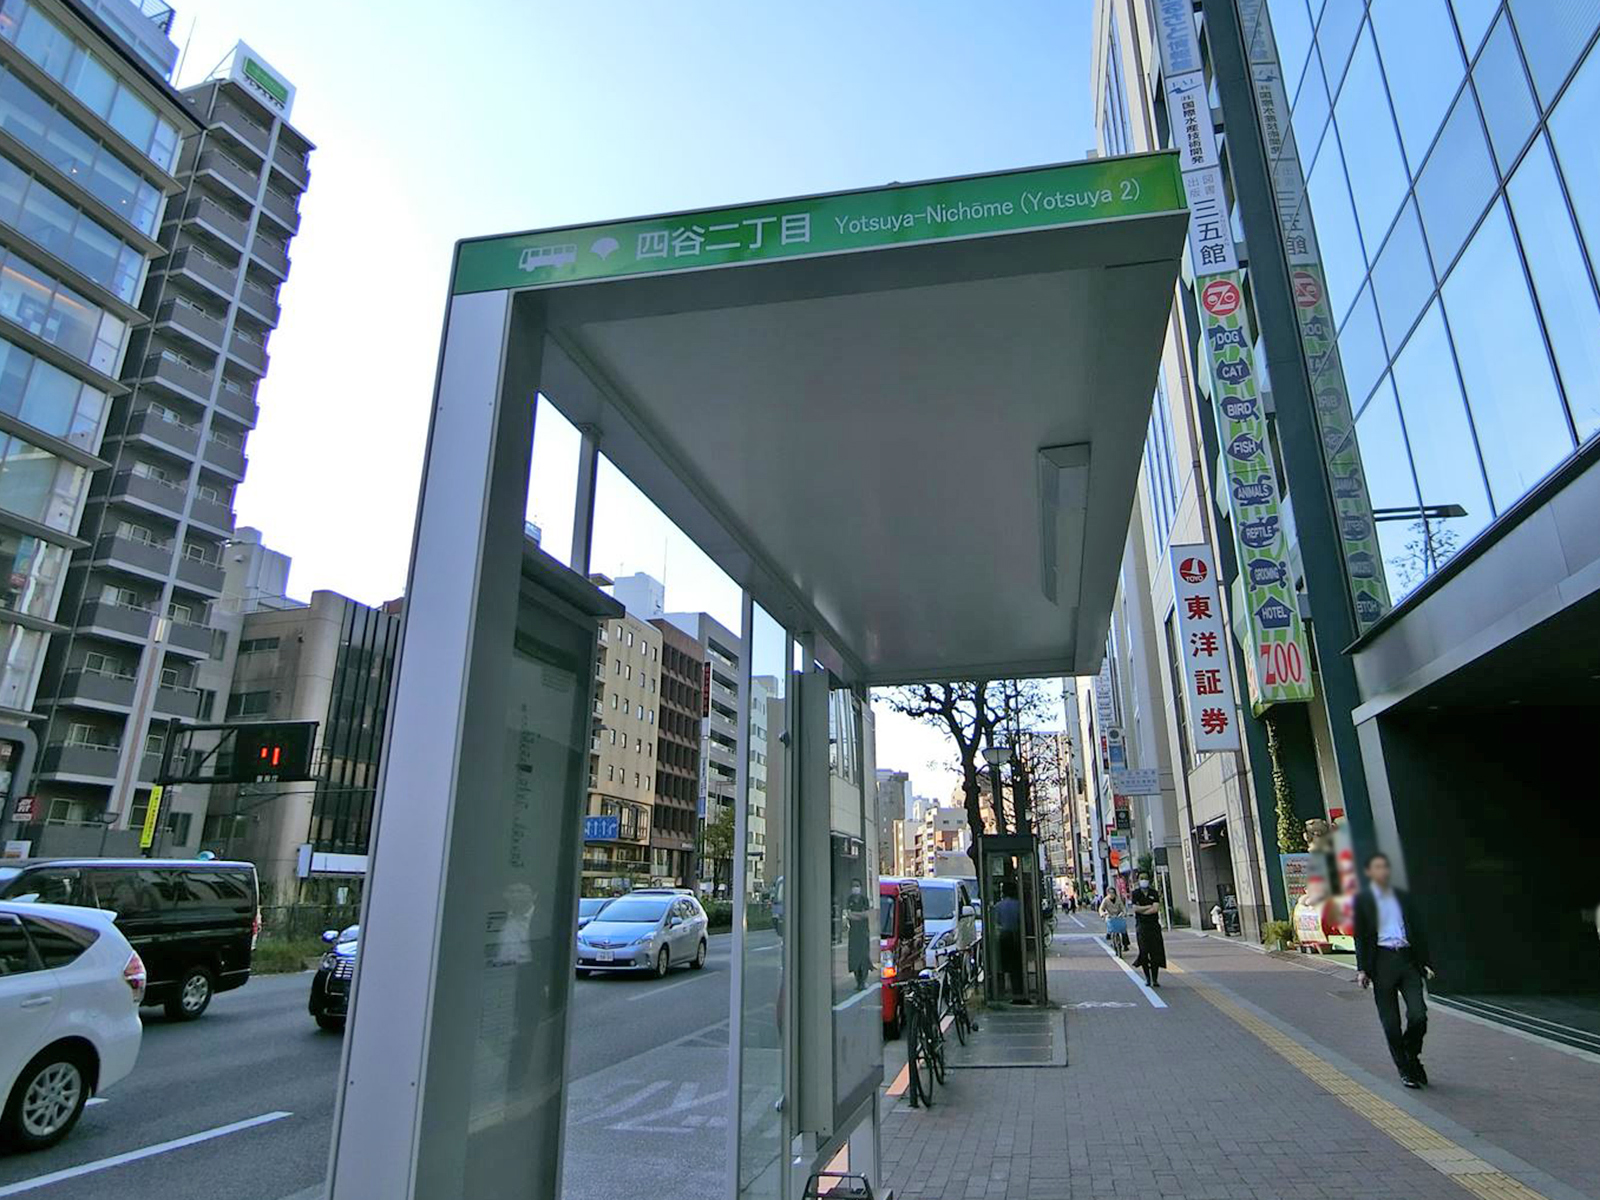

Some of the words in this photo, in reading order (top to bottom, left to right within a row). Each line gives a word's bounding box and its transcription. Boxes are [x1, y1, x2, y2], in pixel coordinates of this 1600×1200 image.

[835, 201, 1014, 235] Yotsuya-Nichōme
[1021, 187, 1112, 214] (Yotsuya
[1120, 178, 1140, 201] 2)
[636, 213, 810, 260] 四谷二丁目
[1194, 199, 1227, 266] 三五館
[1216, 331, 1240, 344] DOG
[1222, 365, 1243, 377] CAT
[1227, 402, 1252, 416] BIRD
[1233, 440, 1256, 454] FISH
[1237, 485, 1270, 499] ANIMALS
[1245, 525, 1273, 539] REPTILE
[1261, 606, 1288, 619] HOTEL
[1184, 595, 1229, 735] 東洋証券
[1260, 642, 1301, 685] ZOO
